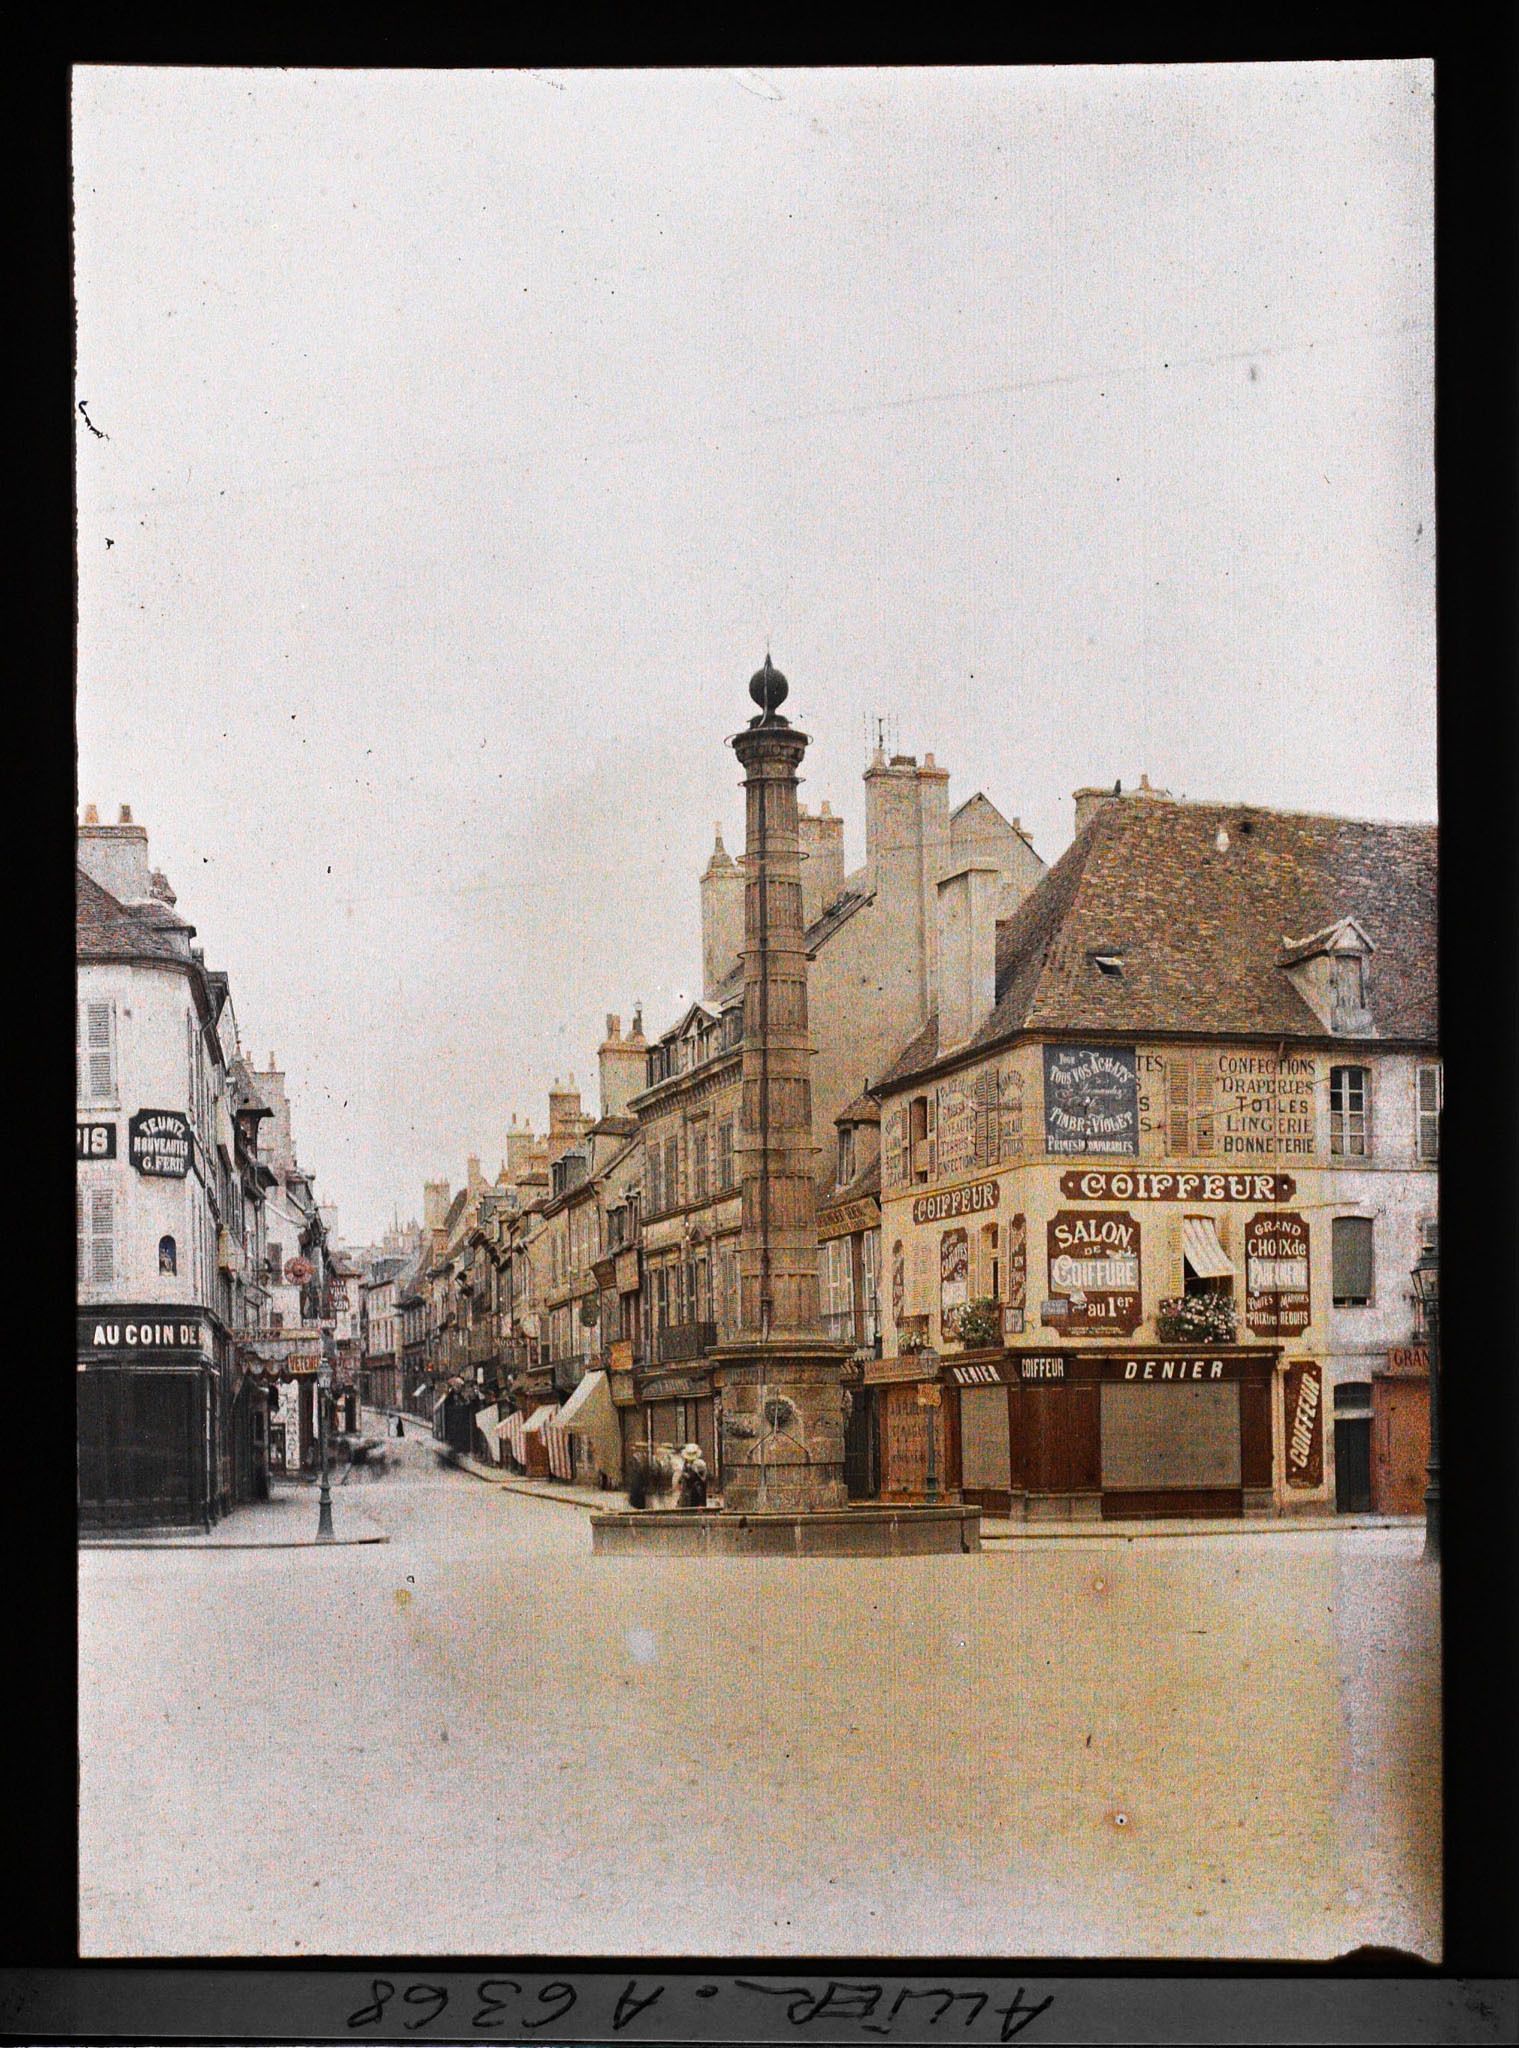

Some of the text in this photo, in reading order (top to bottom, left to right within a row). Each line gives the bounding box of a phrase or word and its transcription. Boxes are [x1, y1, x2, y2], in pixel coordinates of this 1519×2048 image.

[1050, 1065, 1072, 1084] TOUS
[1072, 1063, 1092, 1083] VOS
[1218, 1055, 1316, 1075] CONFECTIONS
[1221, 1076, 1314, 1095] DRAPERIES
[1235, 1096, 1309, 1114] TOILES
[1088, 1110, 1133, 1134] VIOLET
[1226, 1114, 1313, 1134] LINGERIE
[1223, 1135, 1315, 1154] BONNETERIE
[1080, 1172, 1276, 1200] COIFFEUR
[917, 1182, 994, 1222] COIFFEUR
[1054, 1219, 1135, 1250] SALON
[1254, 1221, 1302, 1236] GRAND
[1247, 1239, 1292, 1257] CHOIX
[1052, 1255, 1137, 1288] COIFFURE
[1087, 1302, 1106, 1317] au
[93, 1325, 120, 1345] AU
[125, 1325, 174, 1345] COIN
[953, 1364, 1000, 1384] DENIER
[1021, 1358, 1064, 1378] COIFFEUR
[1124, 1361, 1223, 1379] DENIER
[1289, 1372, 1320, 1469] COIFFEUR
